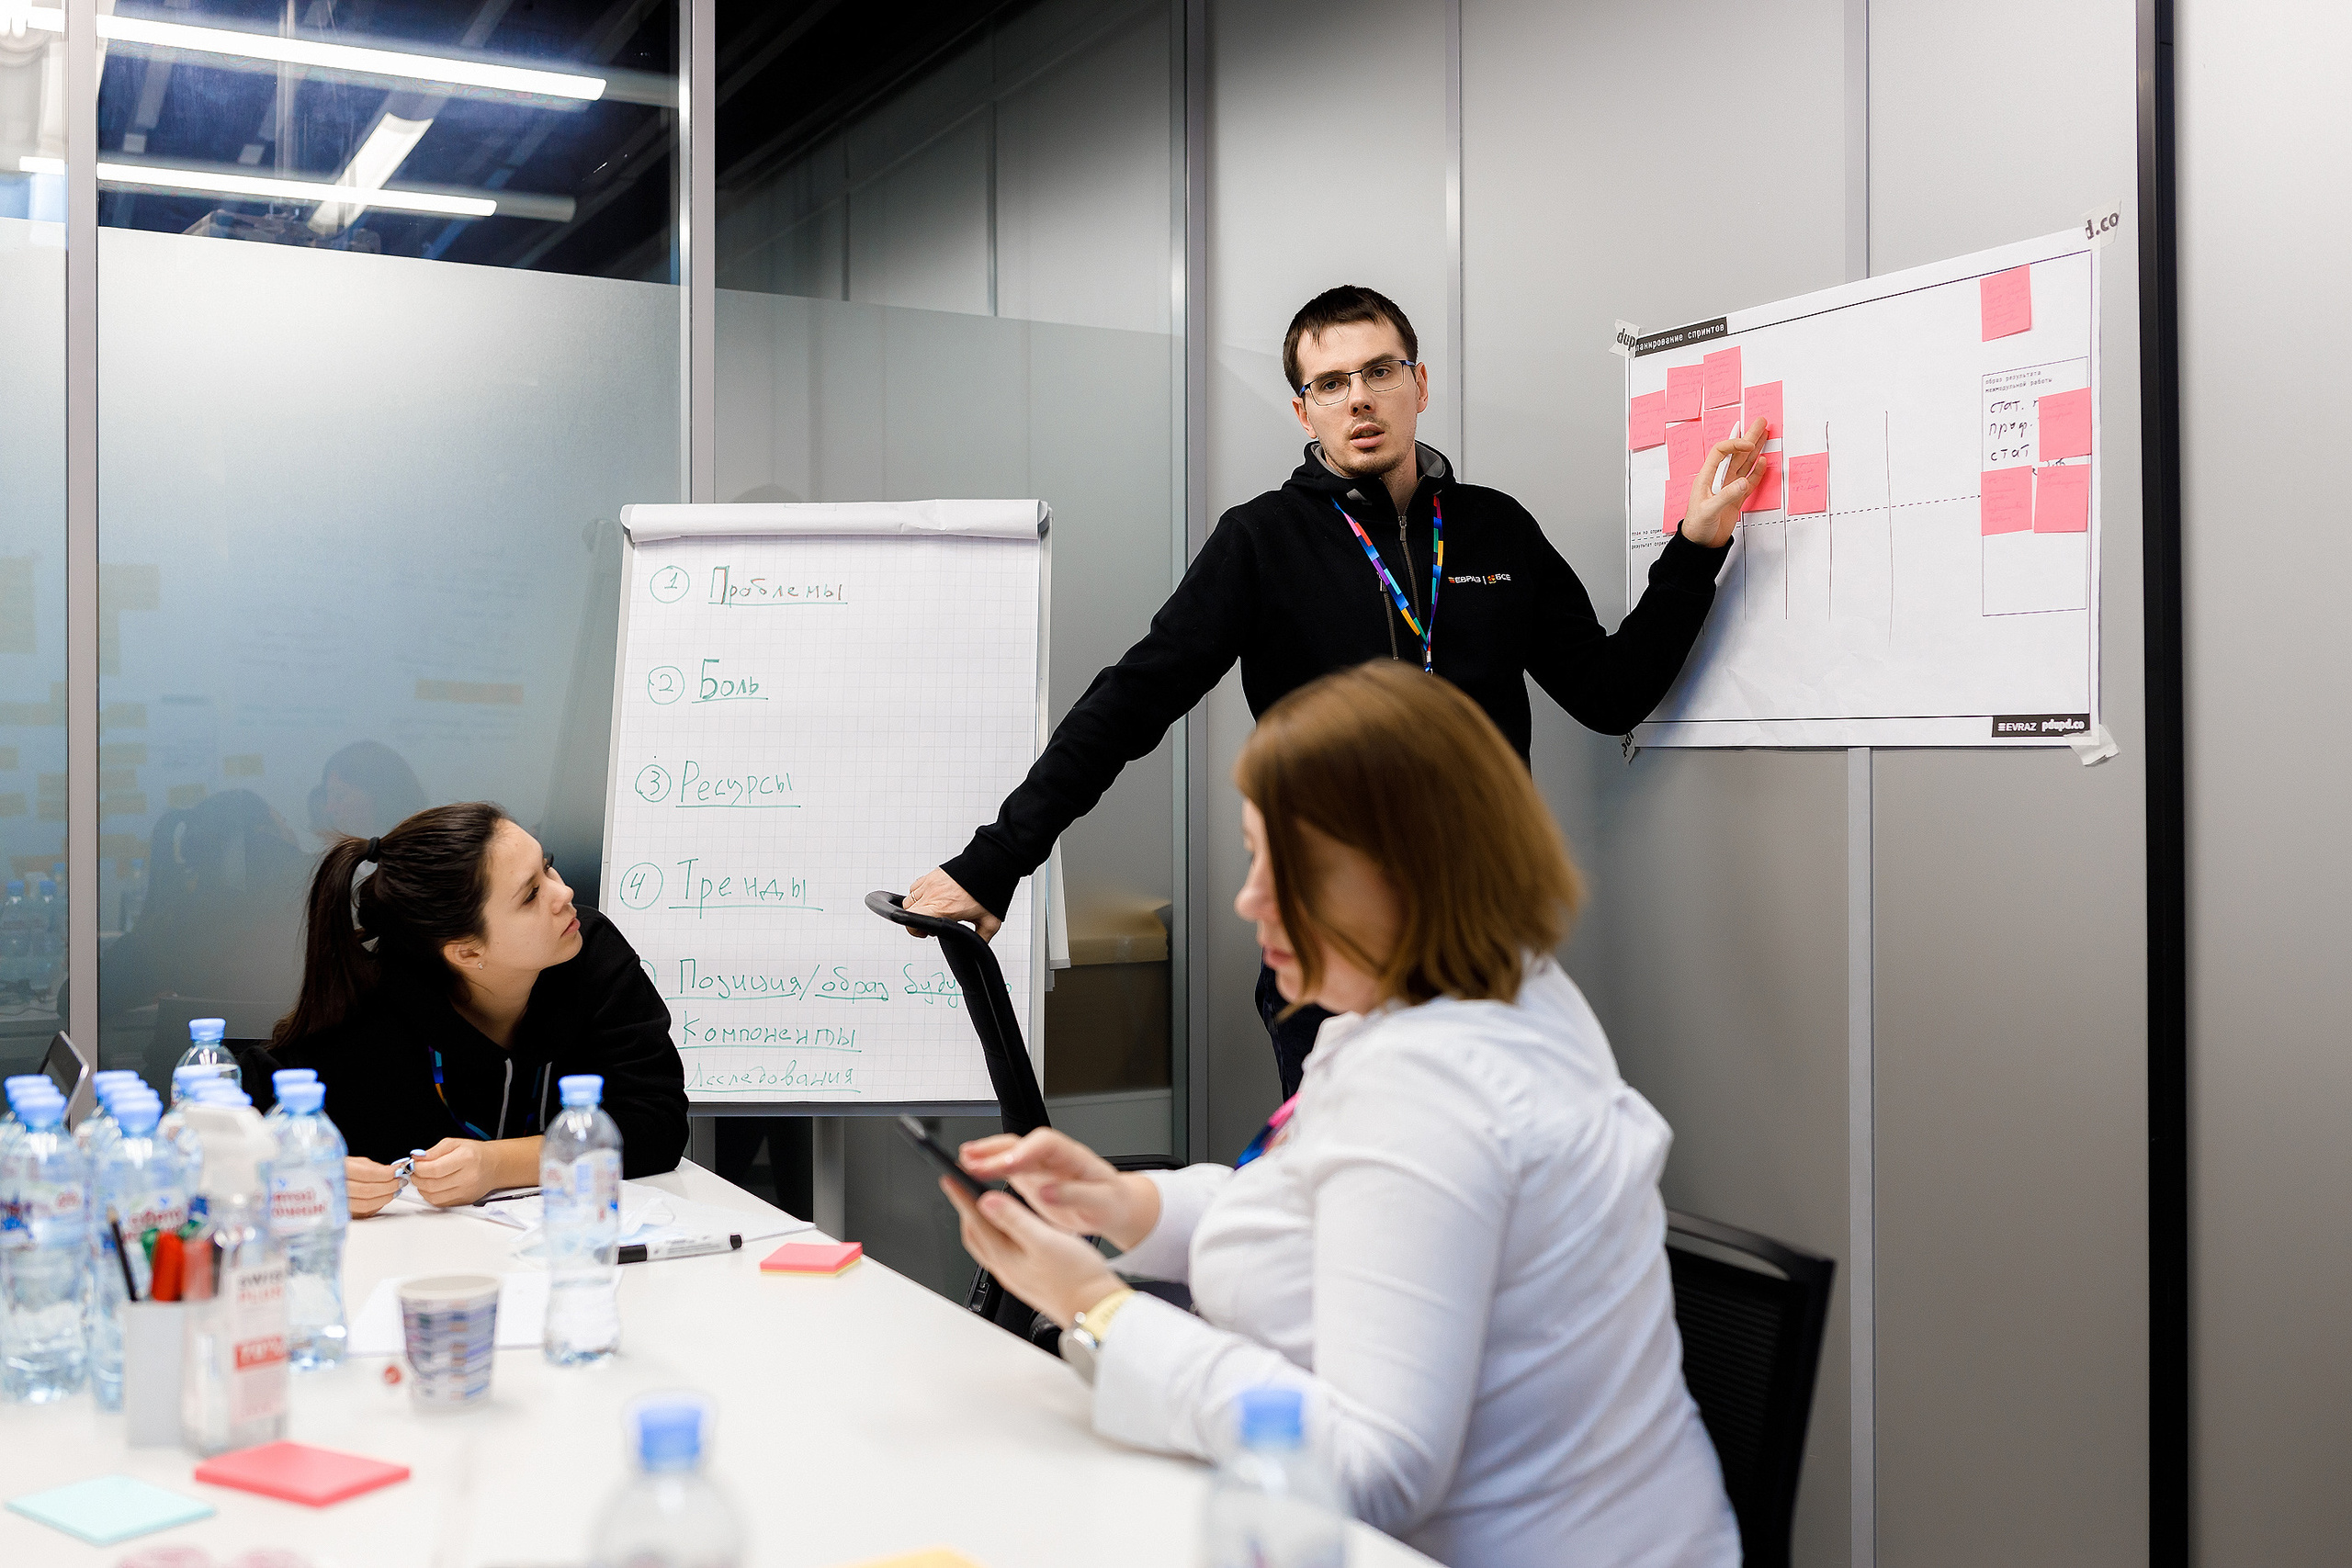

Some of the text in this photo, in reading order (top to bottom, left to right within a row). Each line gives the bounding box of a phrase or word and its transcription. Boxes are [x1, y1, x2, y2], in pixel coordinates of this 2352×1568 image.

[1635, 323, 1724, 353] ланирование спринтов
[1985, 370, 2041, 385] образ результата
[709, 565, 843, 608] Проблемы
[699, 658, 760, 700] Боль
[2006, 718, 2086, 732] EVRAZ pdupd.co
[681, 760, 793, 806] Ресурсы
[676, 857, 807, 919] Тренды
[683, 1010, 856, 1046] Компоненты
